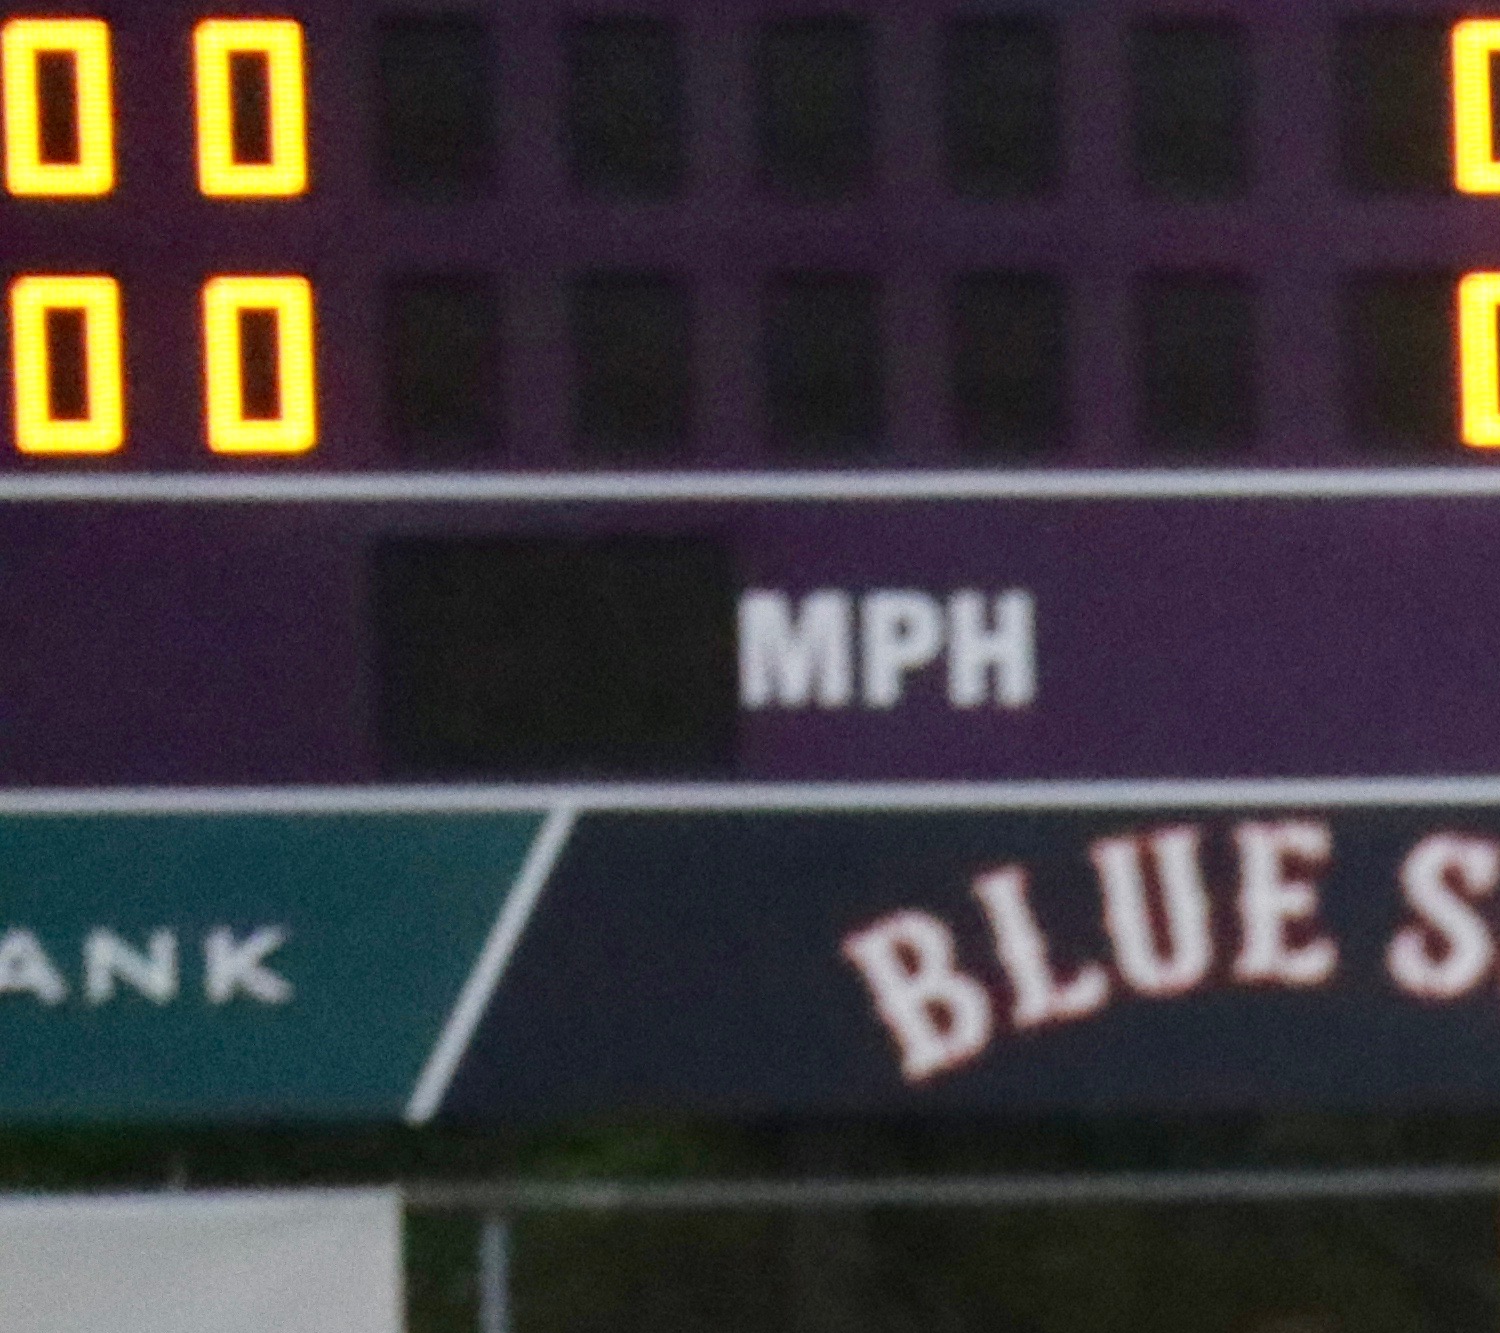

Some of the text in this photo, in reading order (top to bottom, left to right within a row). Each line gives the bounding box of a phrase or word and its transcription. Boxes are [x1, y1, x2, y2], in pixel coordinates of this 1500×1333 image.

[2, 18, 114, 196] 0
[194, 18, 307, 196] 0
[11, 275, 124, 453] 0
[203, 275, 316, 453] 0
[738, 591, 1035, 707] MPH
[841, 818, 1340, 1084] BLUE
